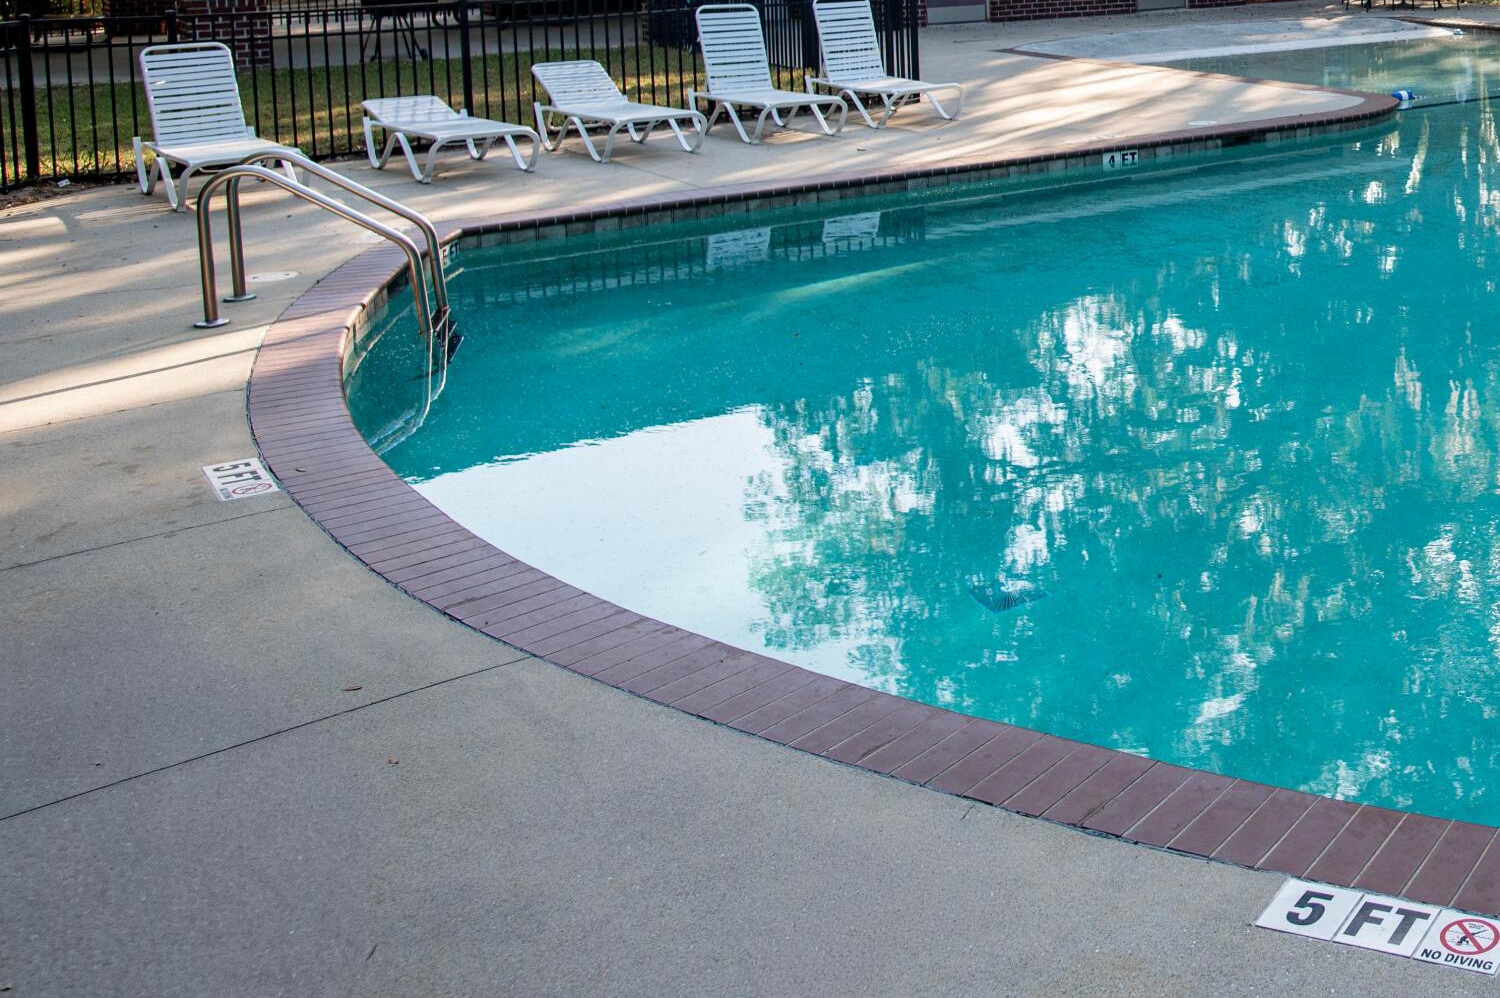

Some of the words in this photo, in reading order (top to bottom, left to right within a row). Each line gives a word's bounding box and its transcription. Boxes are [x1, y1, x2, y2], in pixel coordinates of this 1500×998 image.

[213, 461, 252, 472] 5
[217, 470, 263, 485] FT
[1285, 890, 1334, 926] 5
[1343, 901, 1431, 946] FT
[1420, 948, 1442, 961] NO
[1444, 952, 1494, 971] DIVING
